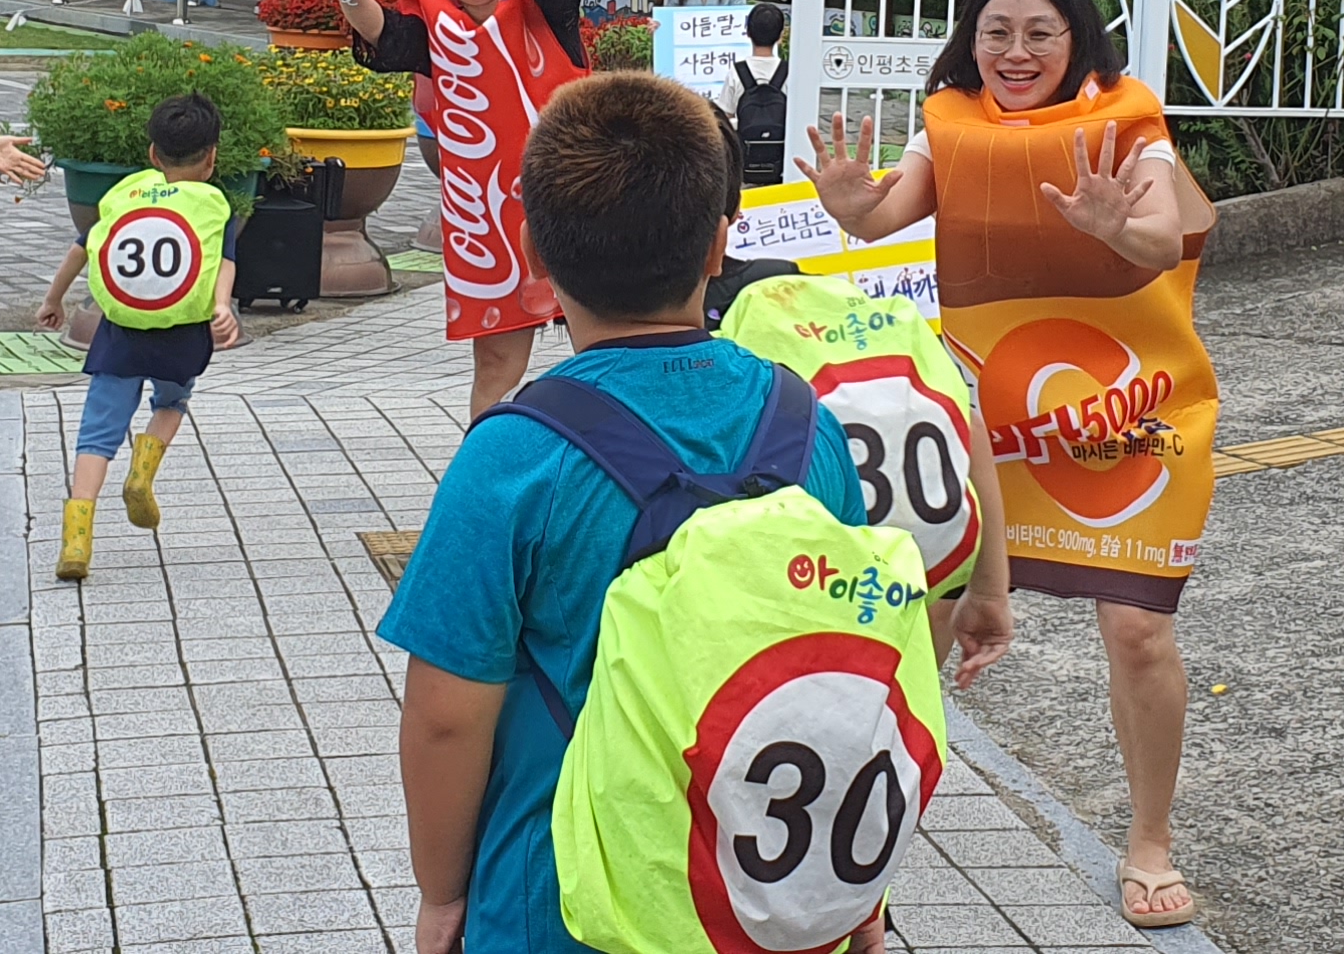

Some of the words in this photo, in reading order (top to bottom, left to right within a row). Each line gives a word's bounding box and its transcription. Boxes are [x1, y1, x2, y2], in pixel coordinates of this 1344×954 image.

[430, 9, 497, 160] Cola
[117, 237, 182, 278] 30
[735, 210, 832, 249] 오늘만큼은
[844, 421, 962, 525] 30
[1100, 534, 1121, 556] 칼슘
[787, 554, 926, 624] 아이좋아
[733, 740, 906, 884] 30
